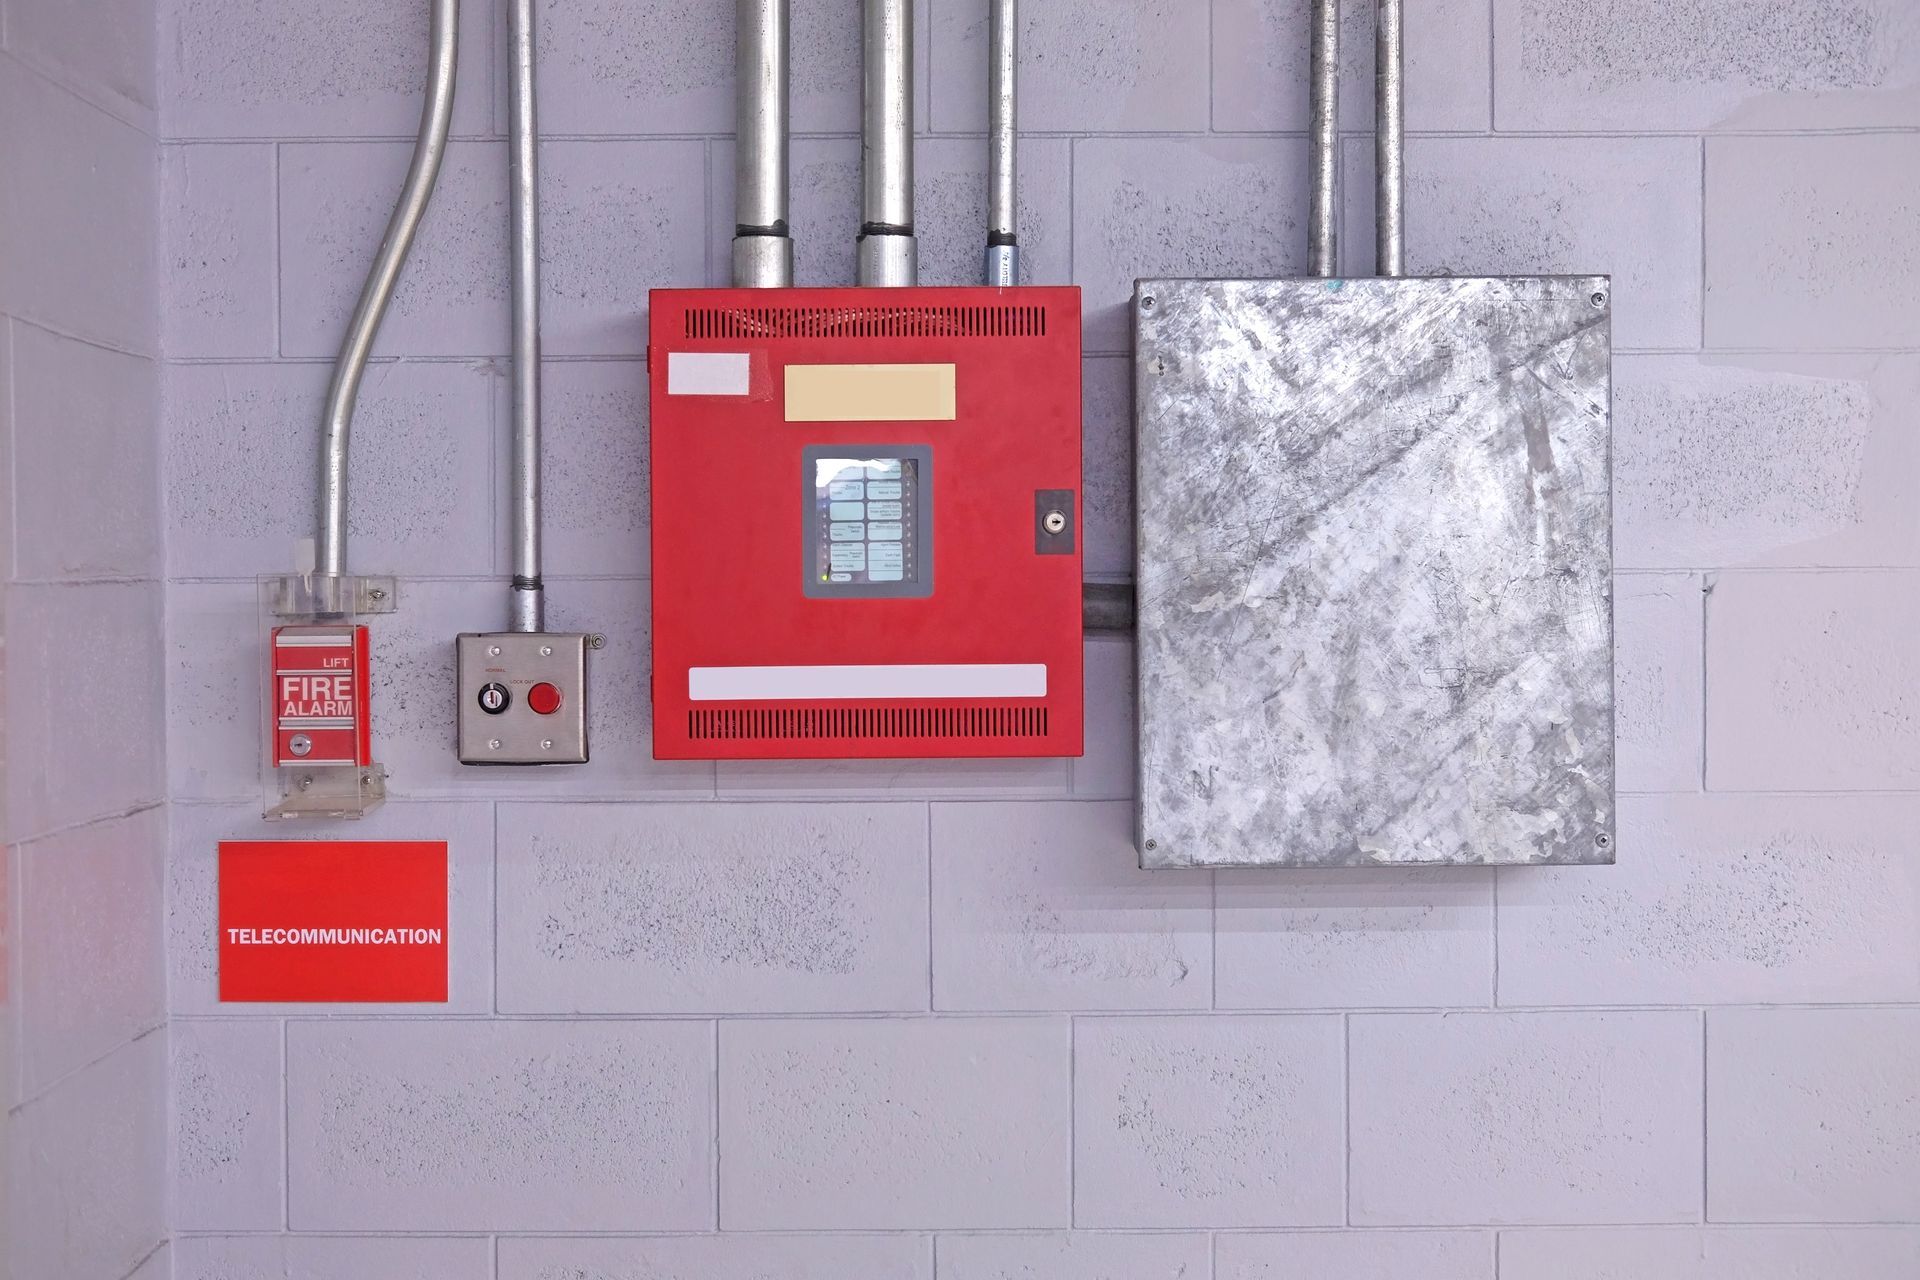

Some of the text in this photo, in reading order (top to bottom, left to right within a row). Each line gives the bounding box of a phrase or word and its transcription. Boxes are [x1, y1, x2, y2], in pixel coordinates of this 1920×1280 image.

[323, 658, 349, 668] LIFT
[283, 677, 352, 701] FIRE
[284, 701, 353, 716] ALARM
[227, 928, 441, 945] TELECOMMUNICATION
